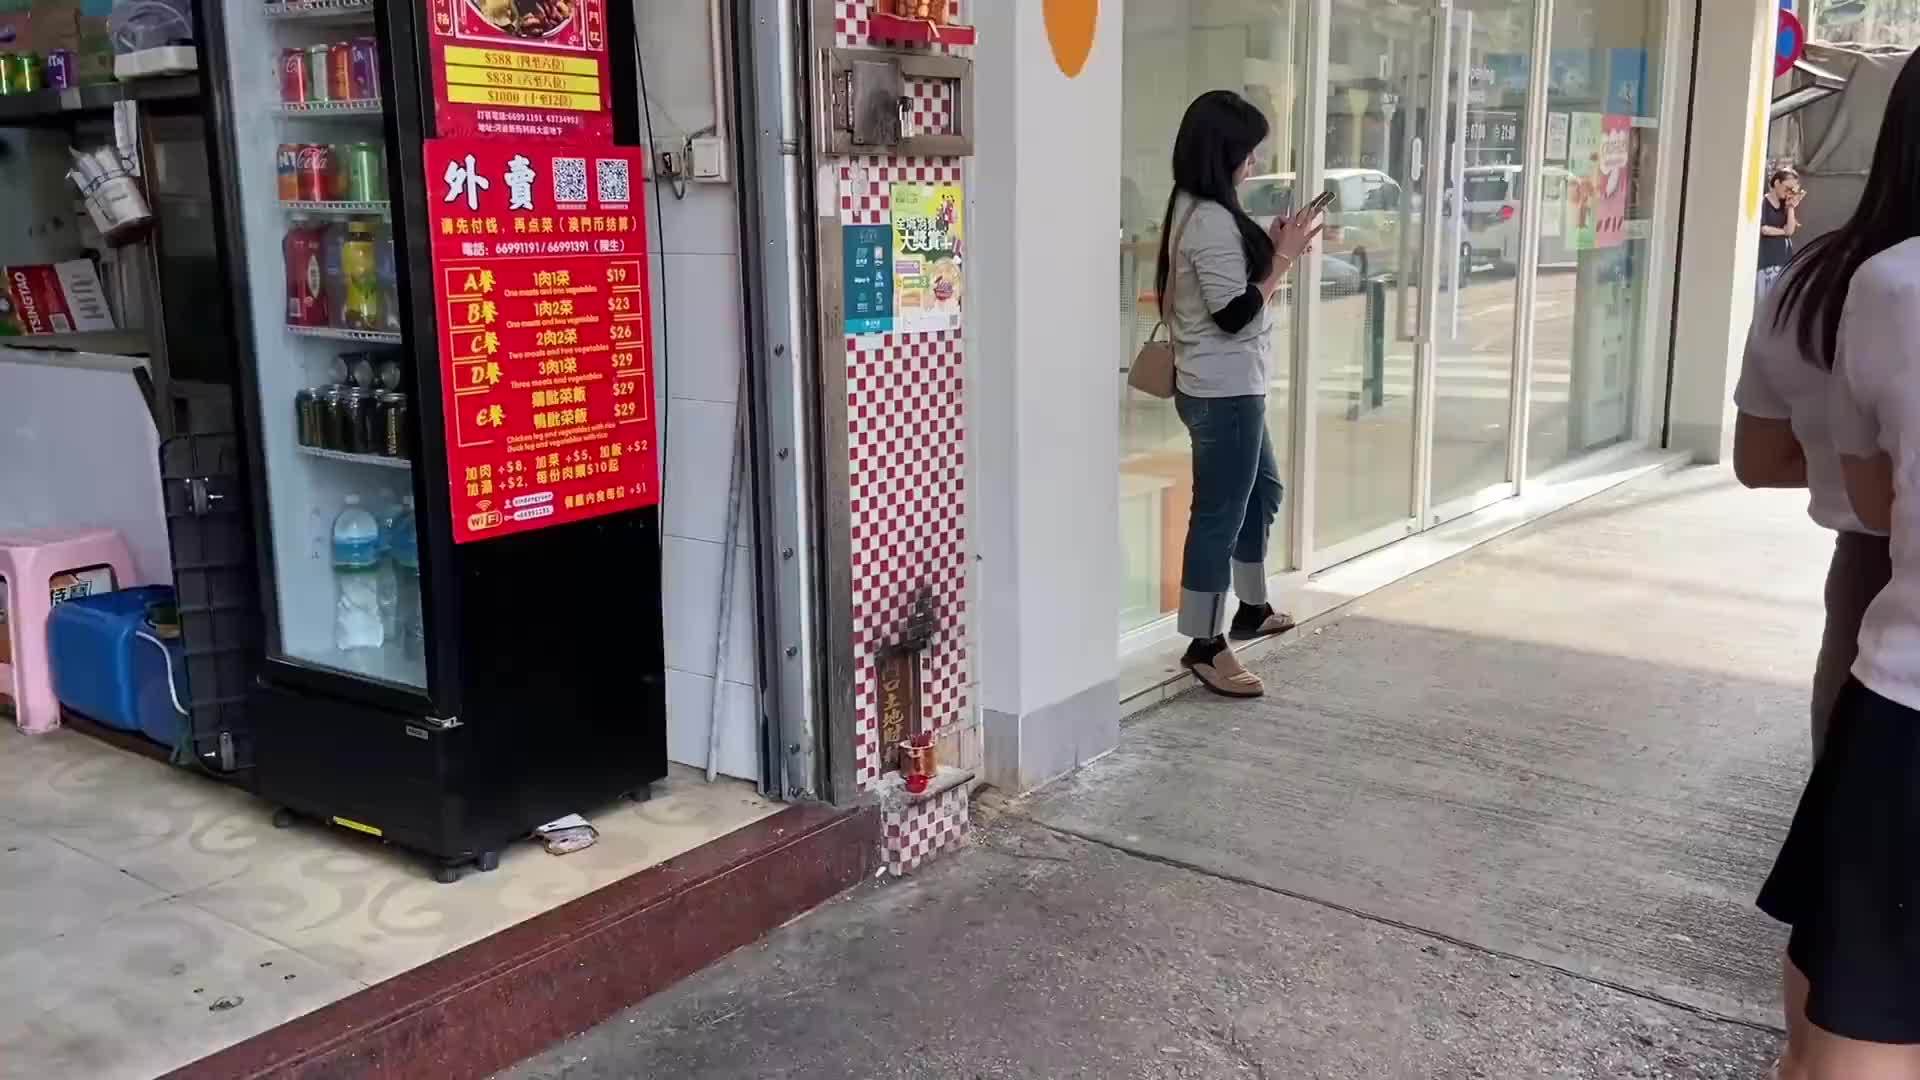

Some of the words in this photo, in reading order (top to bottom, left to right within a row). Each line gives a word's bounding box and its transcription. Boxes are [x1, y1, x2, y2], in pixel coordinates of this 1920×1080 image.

[484, 52, 513, 66] $588
[486, 71, 514, 84] $838
[488, 90, 520, 102] $1000
[606, 268, 626, 283] $19
[608, 296, 630, 311] $23
[609, 325, 632, 340] $26
[611, 353, 633, 368] $29
[613, 381, 635, 397] $29
[614, 402, 636, 418] $29
[465, 464, 492, 480] 加肉
[535, 452, 560, 470] 加菜
[626, 440, 648, 453] +$2
